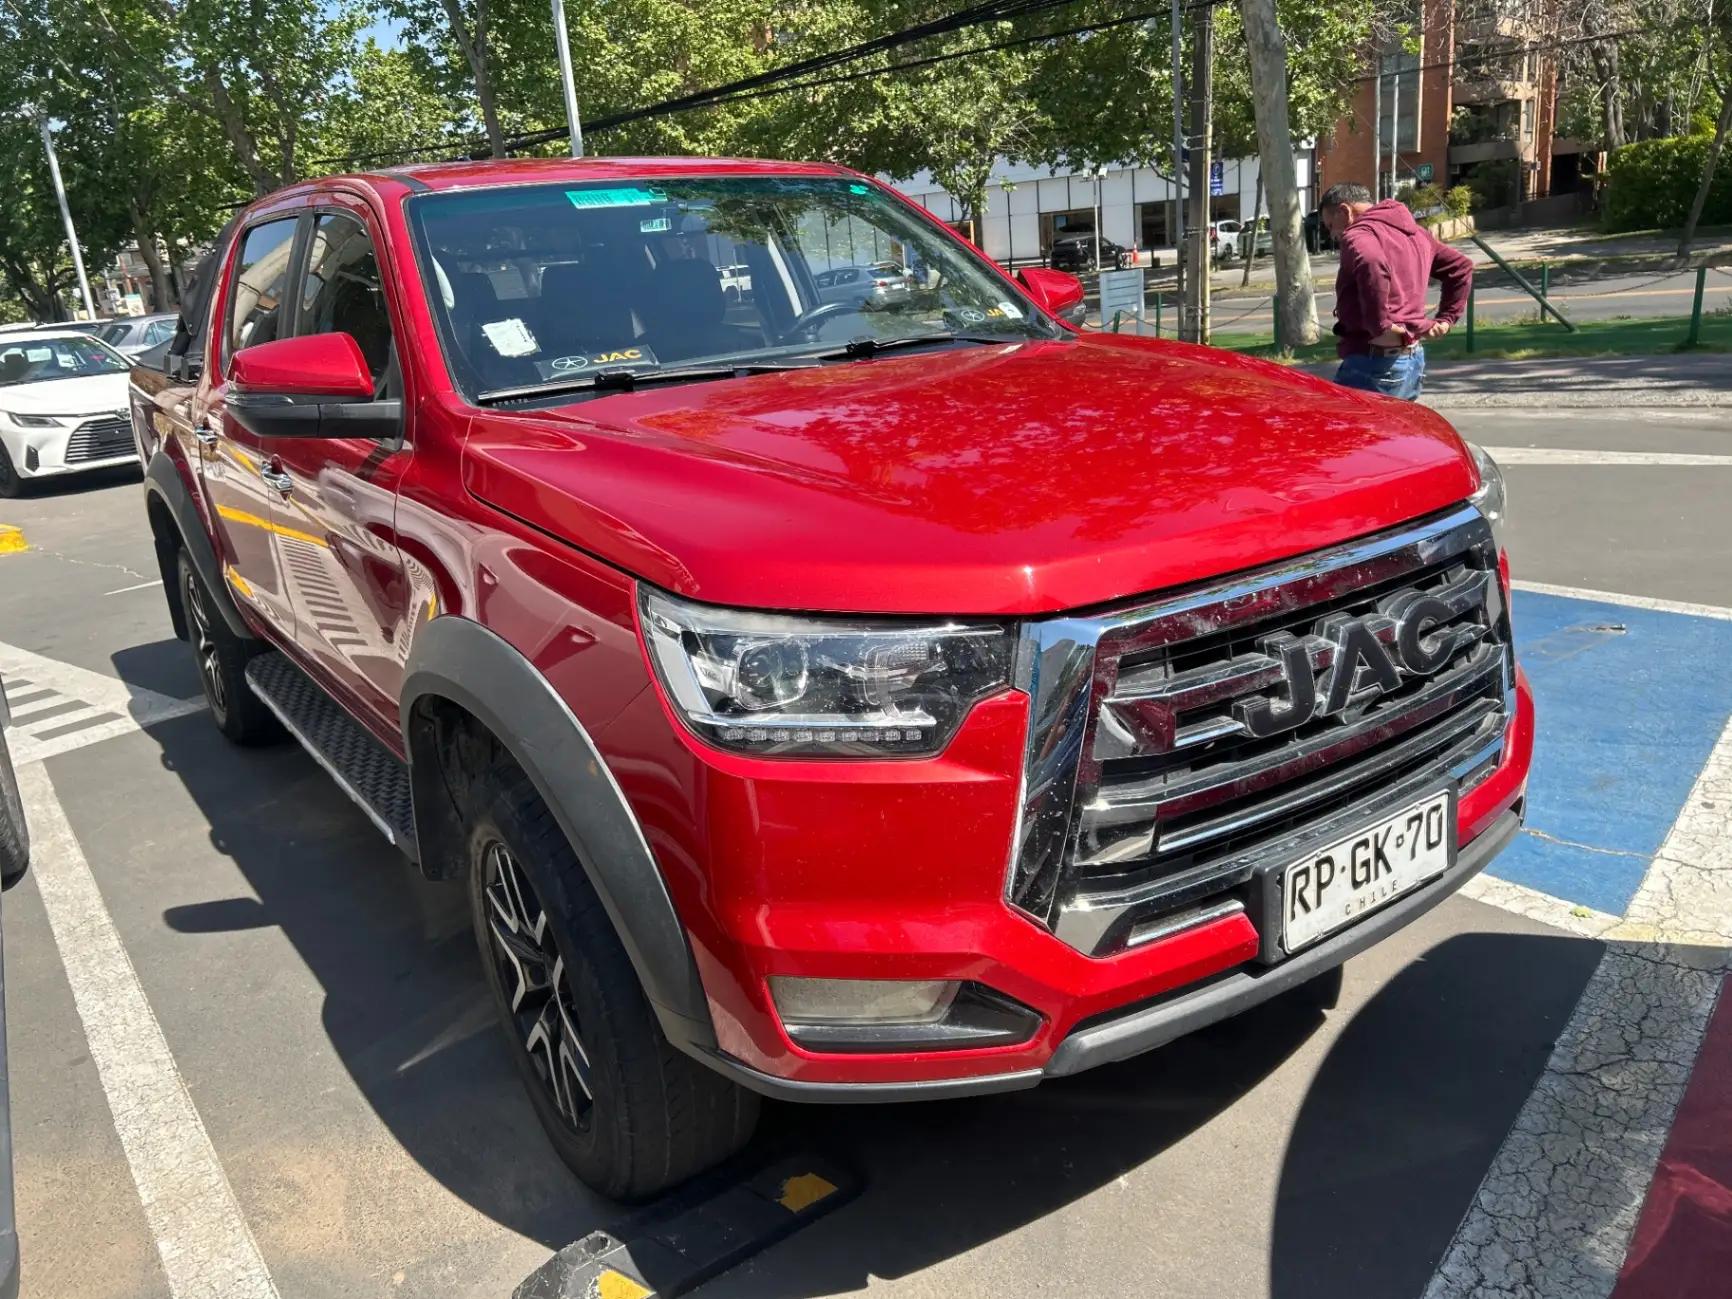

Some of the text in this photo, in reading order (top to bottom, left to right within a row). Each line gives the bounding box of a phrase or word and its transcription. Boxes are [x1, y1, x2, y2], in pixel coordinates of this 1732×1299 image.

[592, 349, 642, 364] JAC
[1232, 588, 1457, 738] JAC
[1344, 879, 1400, 916] CHILE
